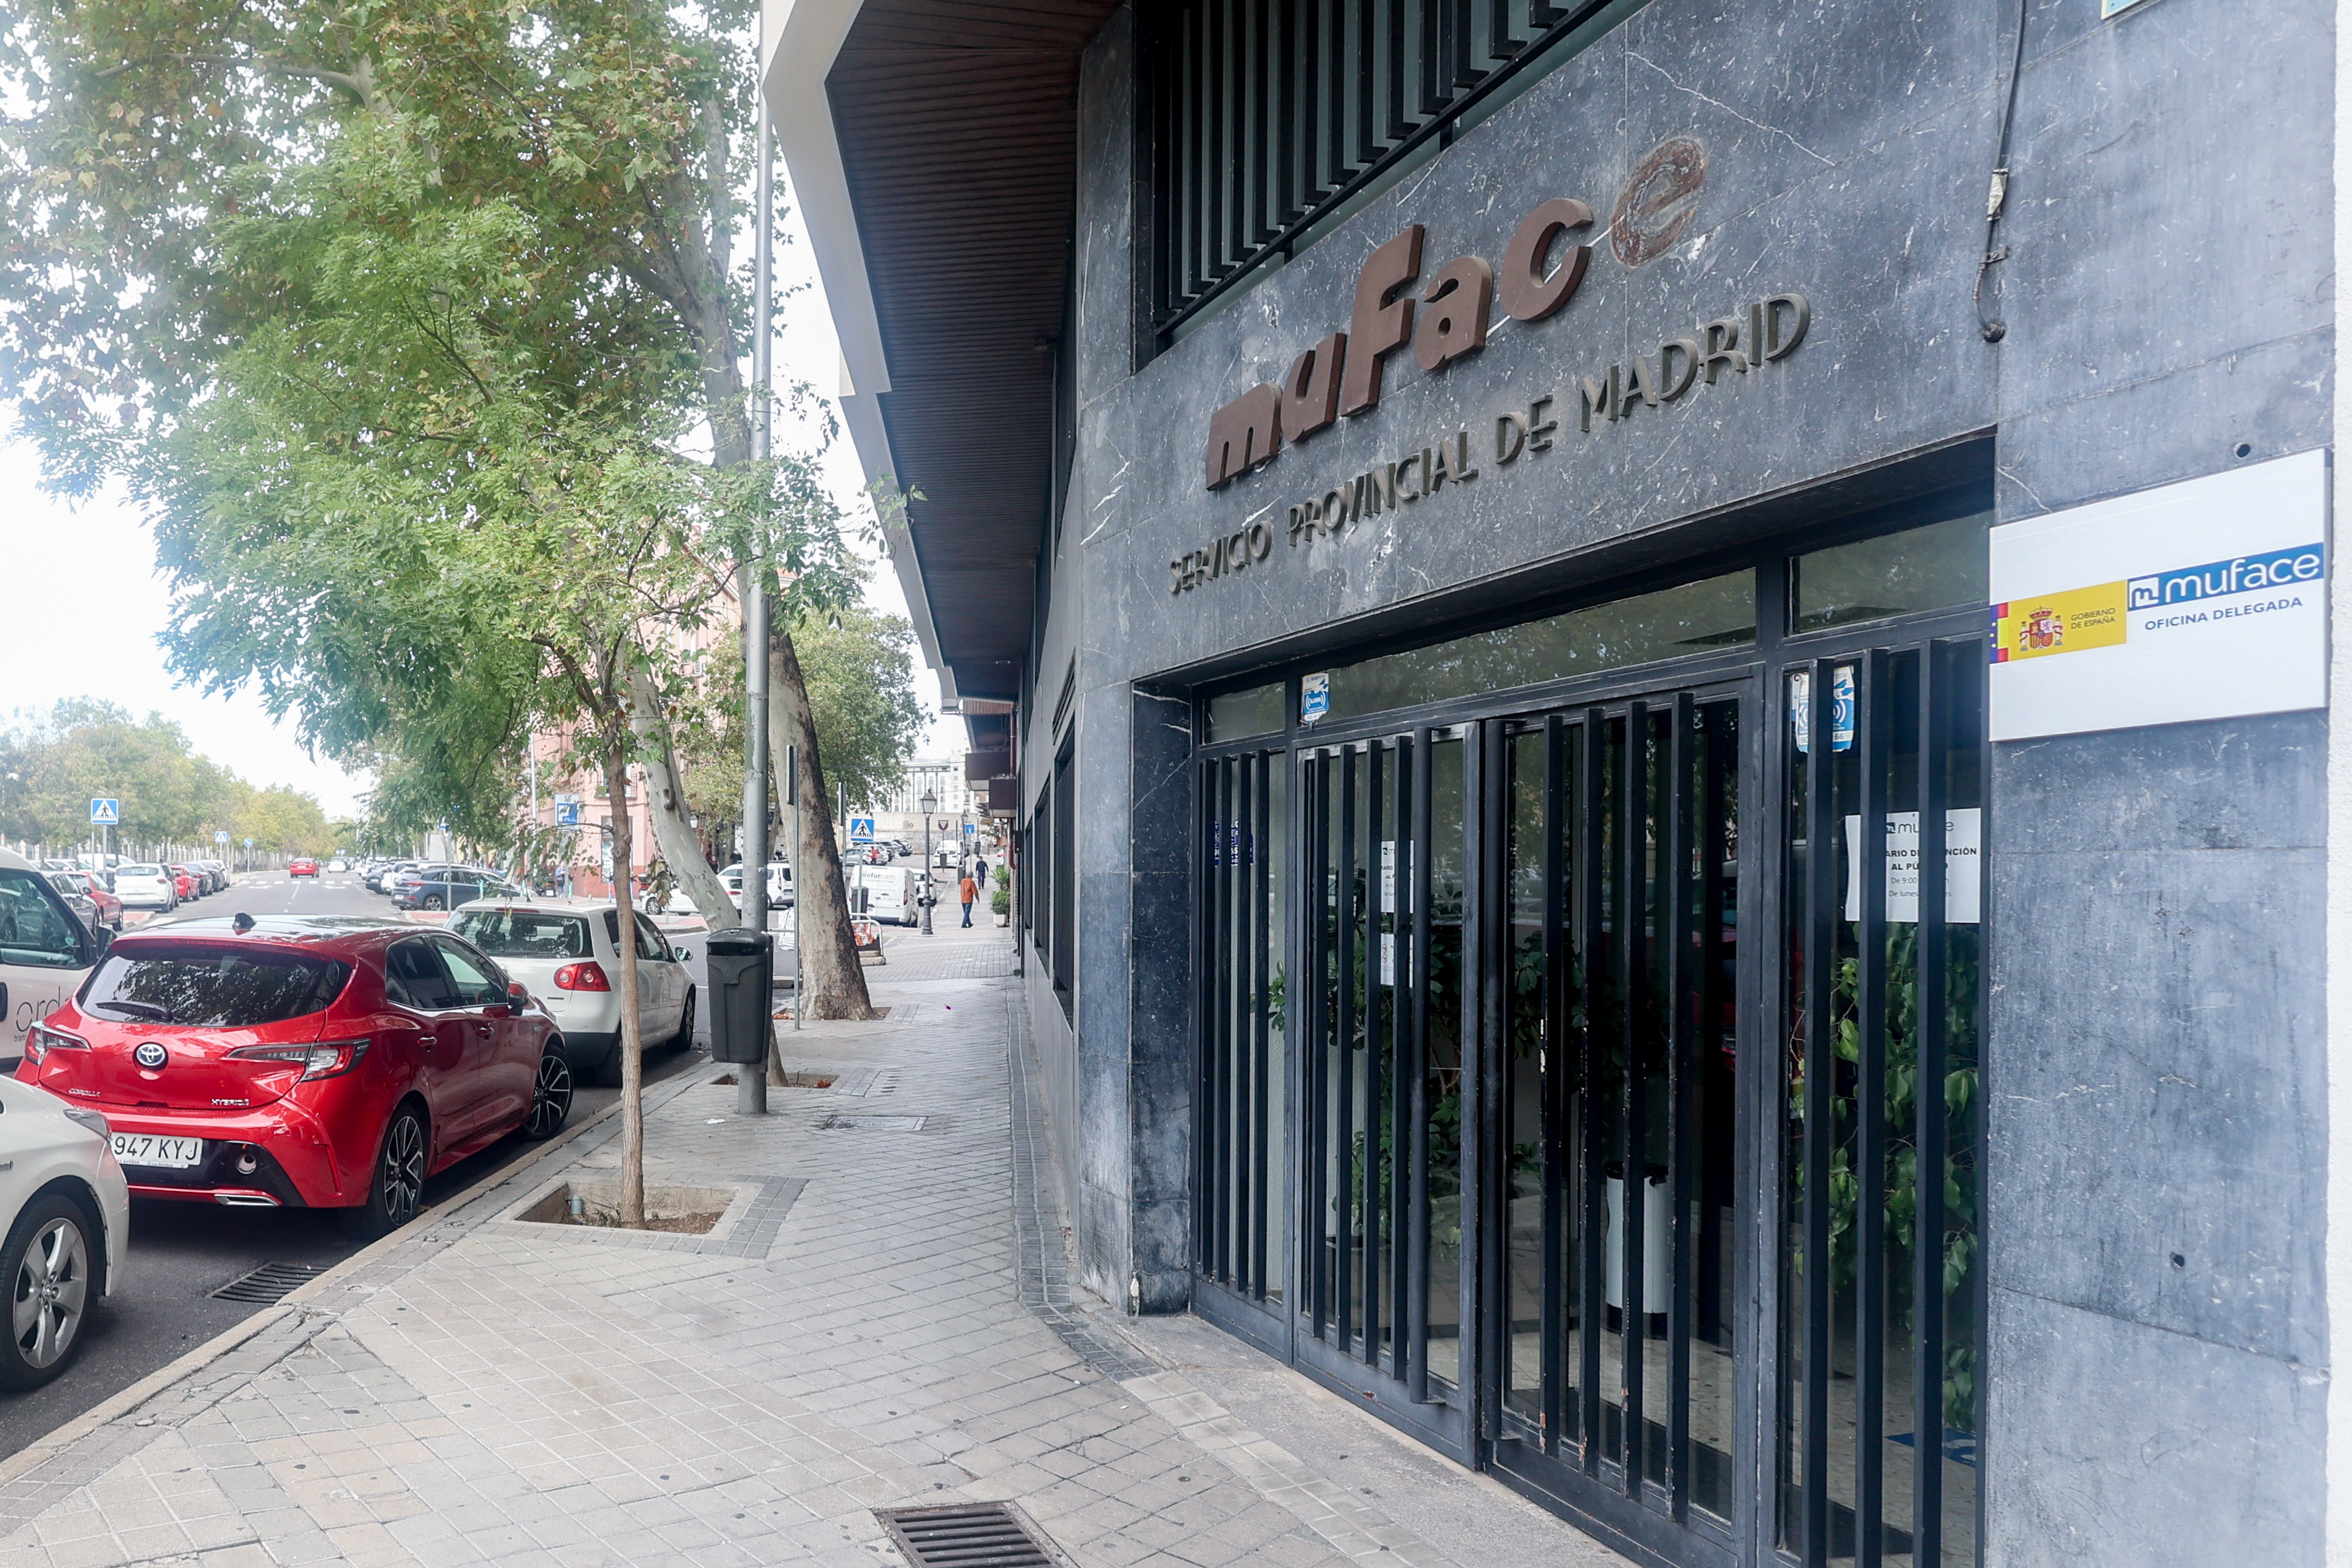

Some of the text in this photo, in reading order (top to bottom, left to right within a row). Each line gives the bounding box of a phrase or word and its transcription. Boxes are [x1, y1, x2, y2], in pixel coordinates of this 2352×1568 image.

[1207, 135, 1707, 491] muface
[1169, 293, 1810, 594] SERVICIO PROVINCIAL DE MADRID
[2165, 553, 2320, 603] muface
[2071, 608, 2115, 621] GOBIERNO
[2084, 616, 2115, 627] ESPAÑA
[2145, 597, 2303, 630] OFICINA DELEGADA
[16, 986, 69, 1032] ord
[111, 1136, 198, 1161] 947 KYJ
